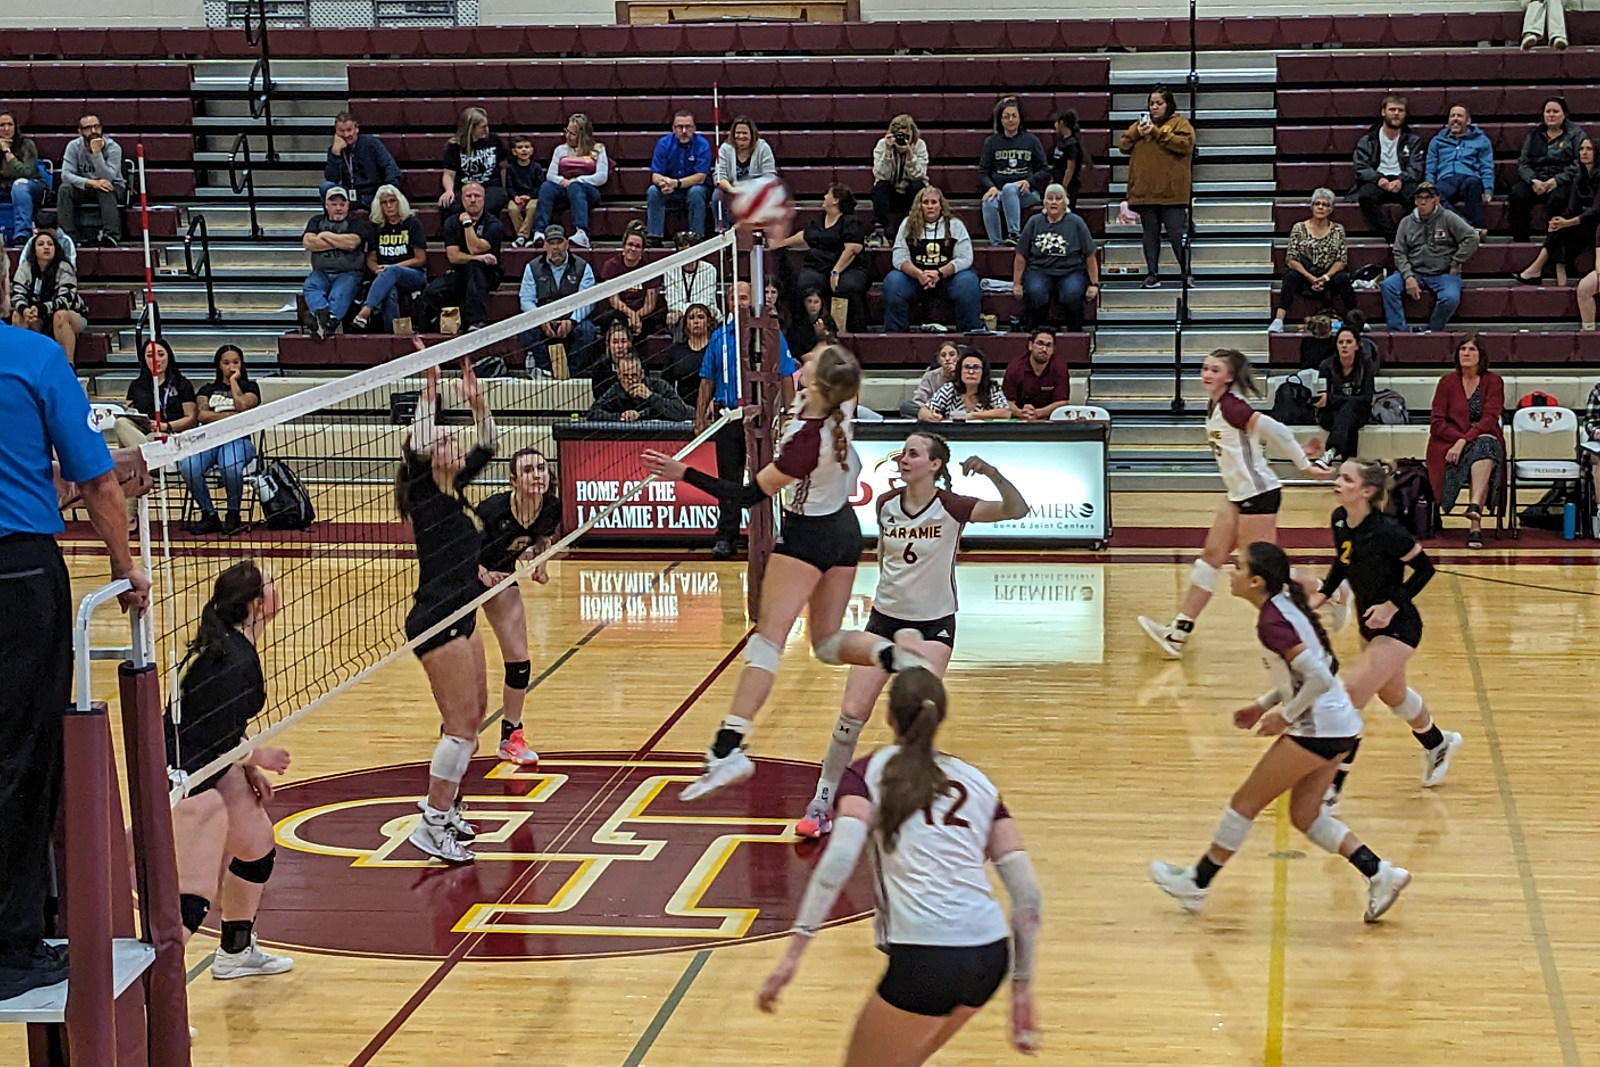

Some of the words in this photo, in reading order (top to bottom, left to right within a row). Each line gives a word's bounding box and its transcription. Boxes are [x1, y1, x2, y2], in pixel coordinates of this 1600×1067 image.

[1540, 411, 1553, 428] LP
[576, 481, 620, 502] HOME
[623, 481, 643, 502] OF
[647, 481, 676, 502] THE
[577, 505, 654, 529] LARAMIE
[1028, 503, 1078, 518] MIER
[882, 525, 942, 539] LARAMIE
[1029, 521, 1054, 529] Joint
[1056, 521, 1095, 529] Centers
[902, 543, 918, 564] 6
[1340, 541, 1352, 565] 2
